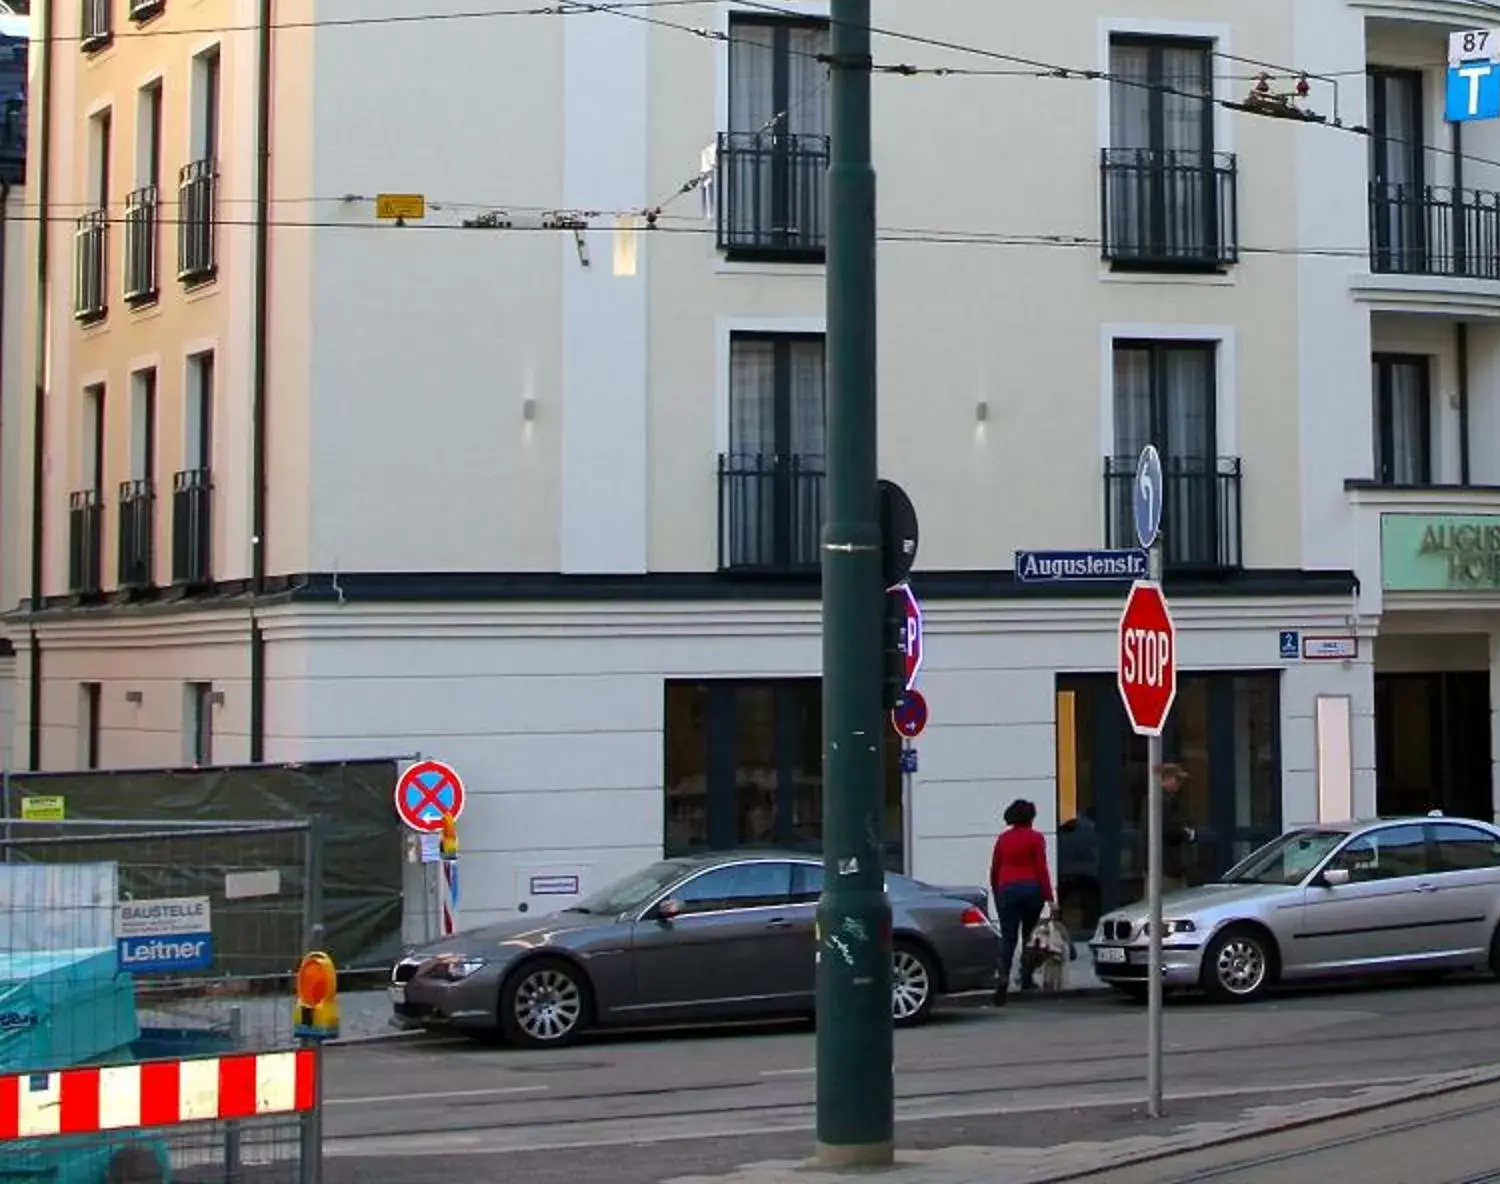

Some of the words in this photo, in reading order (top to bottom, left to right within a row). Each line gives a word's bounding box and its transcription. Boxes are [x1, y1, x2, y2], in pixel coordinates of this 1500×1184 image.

[1463, 32, 1489, 52] 87
[1458, 67, 1490, 114] T
[1024, 554, 1145, 579] Augustenstr.
[1125, 627, 1169, 687] STOP
[122, 903, 202, 920] BAUSTELLE
[122, 940, 206, 963] Leitner
